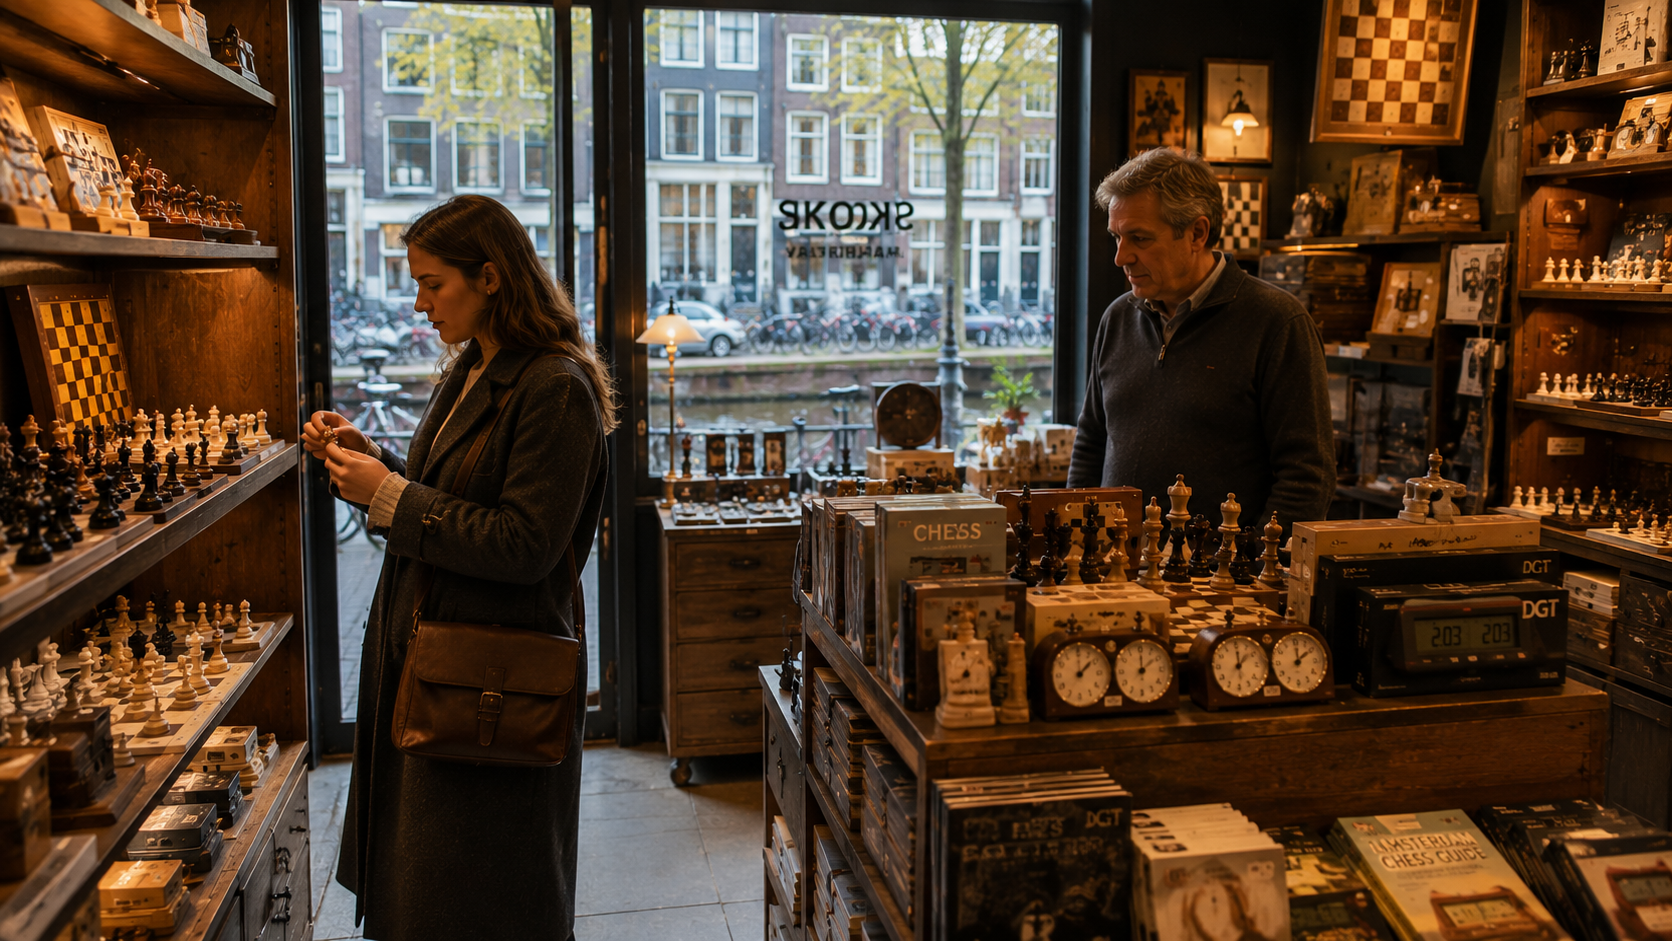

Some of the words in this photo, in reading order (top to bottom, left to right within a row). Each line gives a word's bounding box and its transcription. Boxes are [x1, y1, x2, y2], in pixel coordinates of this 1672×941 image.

[913, 522, 982, 542] CHESS
[1522, 560, 1552, 574] DGT
[1522, 599, 1560, 619] DGT
[1085, 808, 1123, 828] DGT
[1382, 851, 1435, 869] CHESS
[1436, 847, 1488, 864] GUIDE
